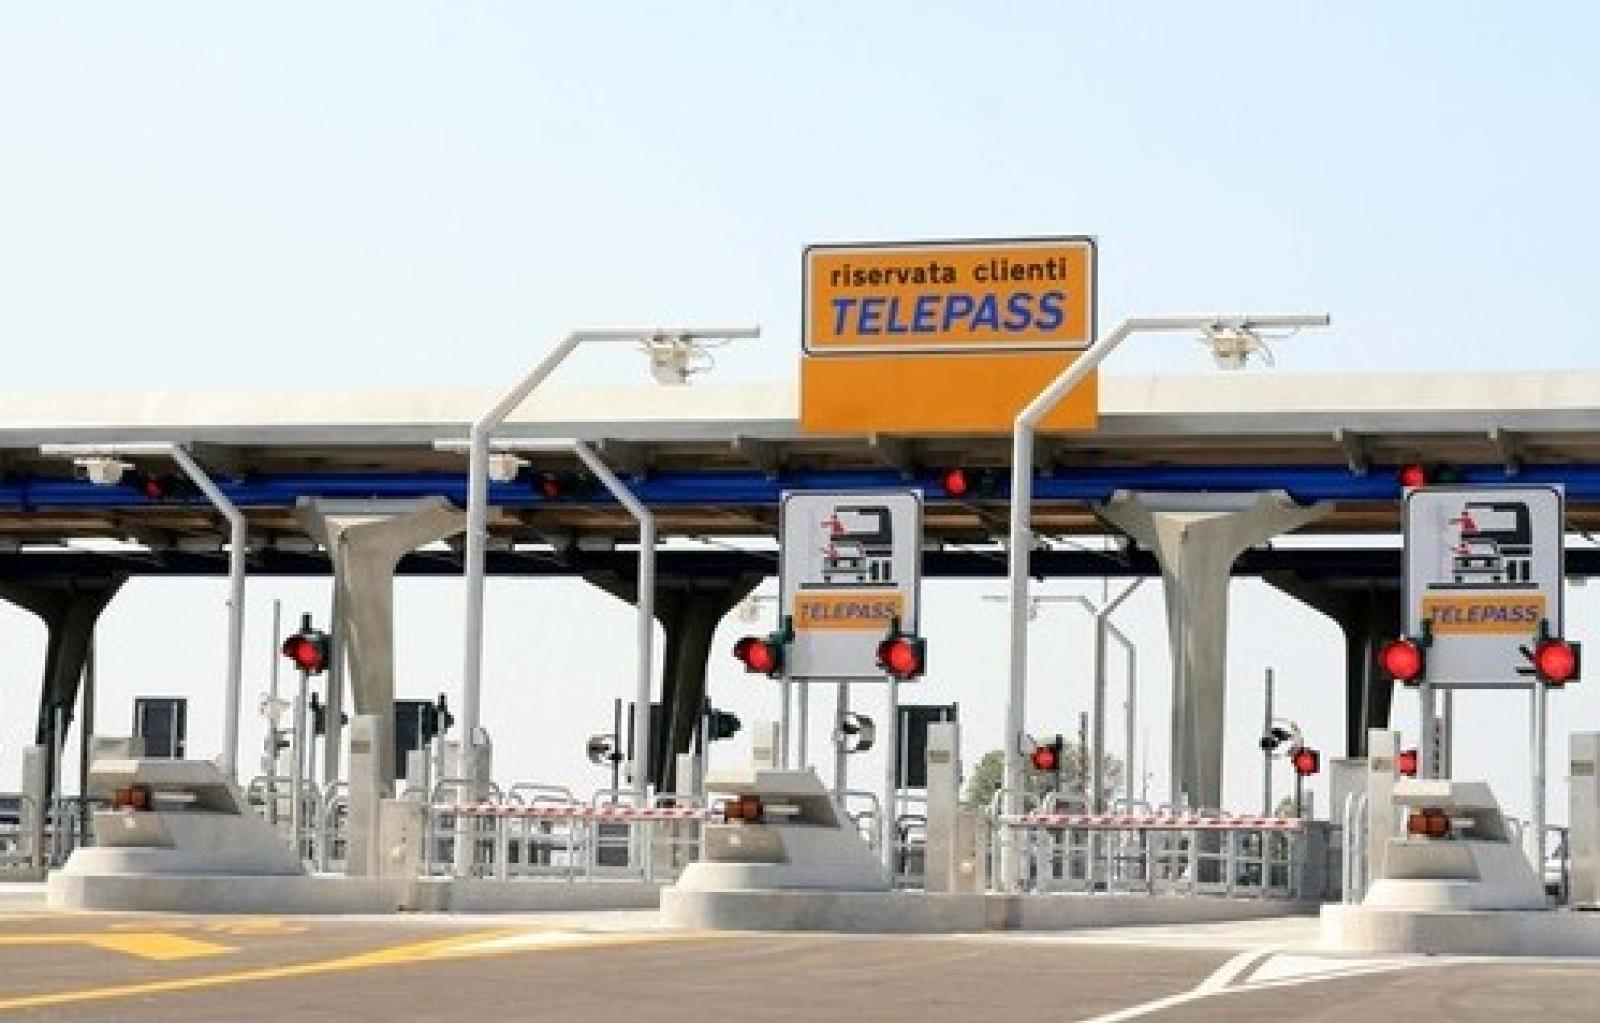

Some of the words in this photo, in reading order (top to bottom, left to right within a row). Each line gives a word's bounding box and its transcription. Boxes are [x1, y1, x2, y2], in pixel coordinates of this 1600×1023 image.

[830, 262, 957, 287] riservata
[972, 257, 1067, 281] clienti
[831, 290, 1067, 336] TELEPASS
[1430, 605, 1540, 623] TELEPASS
